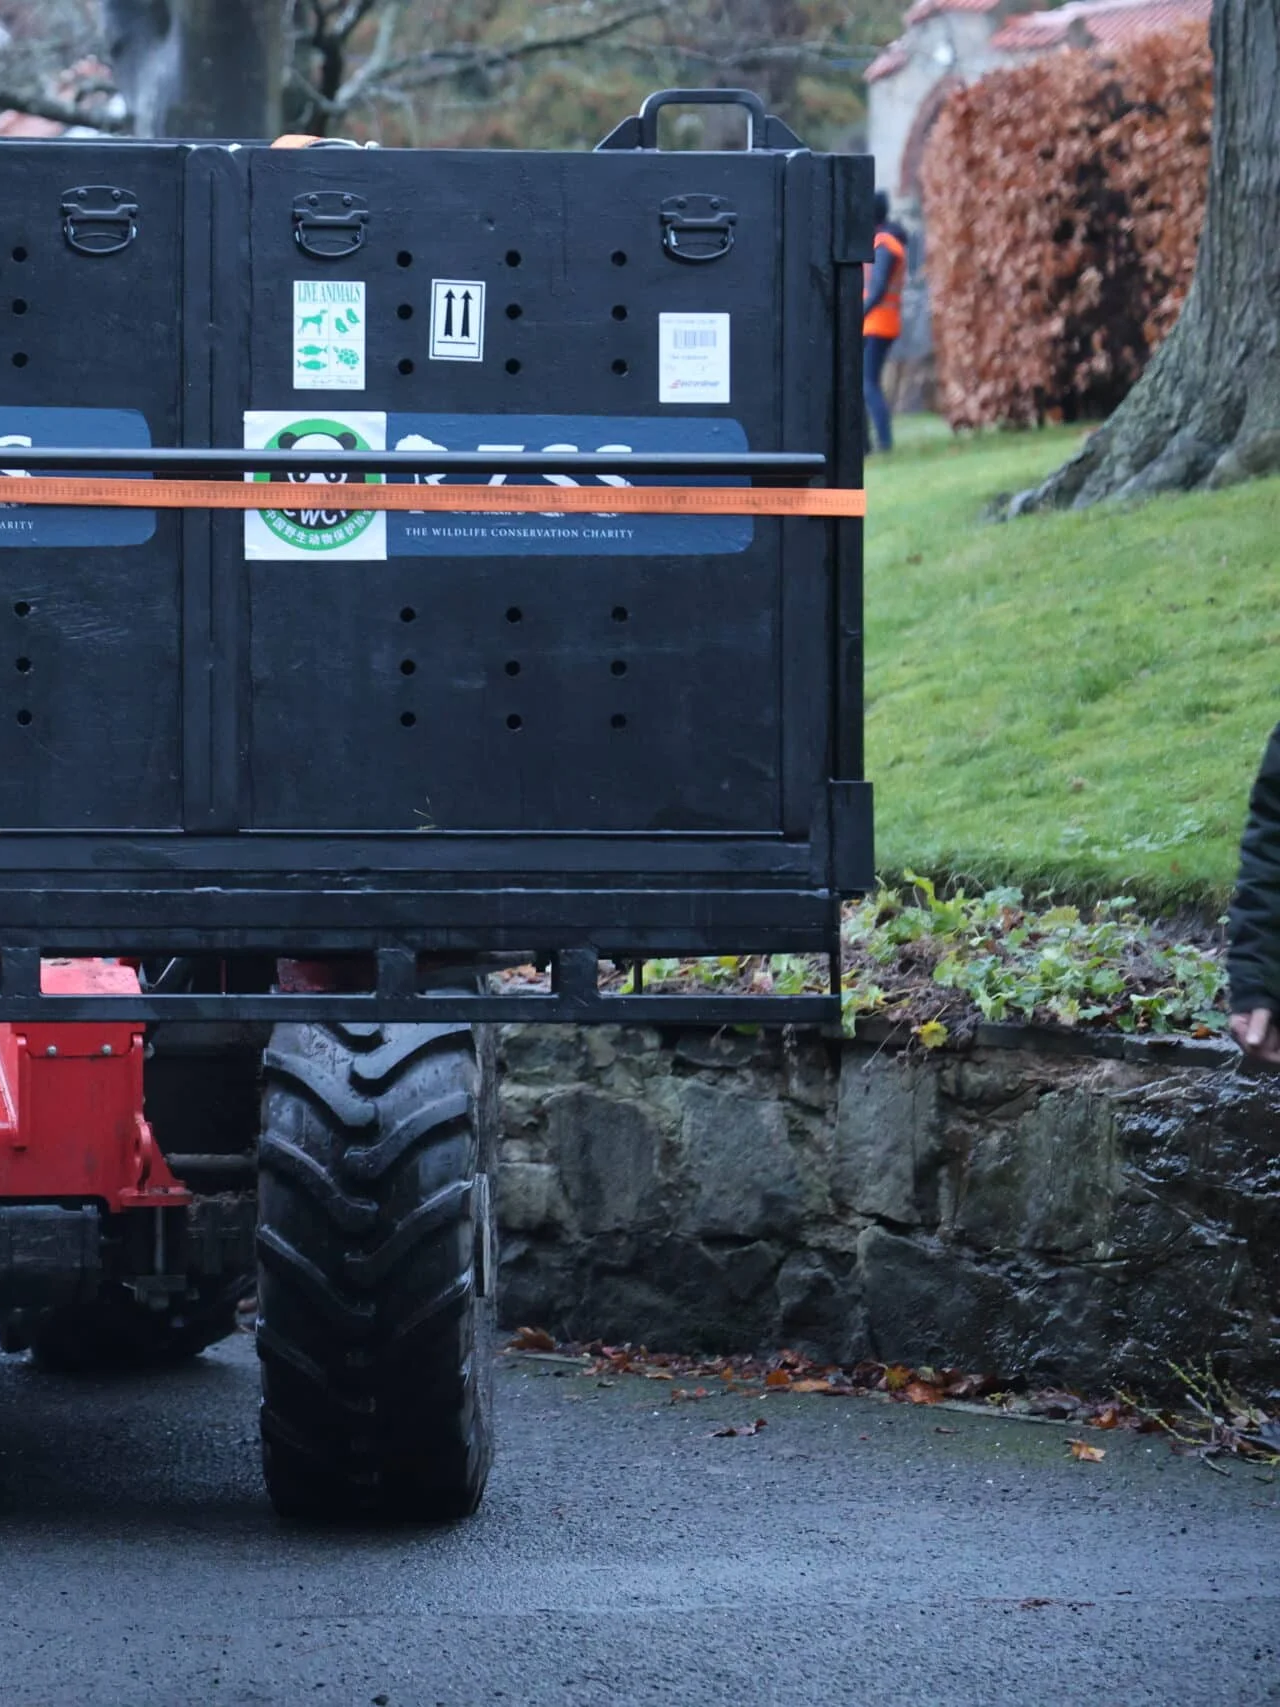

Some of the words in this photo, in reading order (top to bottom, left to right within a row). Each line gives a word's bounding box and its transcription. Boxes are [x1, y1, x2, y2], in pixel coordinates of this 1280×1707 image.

[298, 283, 319, 302] LIVE
[320, 283, 361, 303] ANIMALS
[405, 527, 428, 537] THE
[431, 527, 487, 537] WILDLIFE
[491, 527, 579, 538] CONSERVATION
[582, 528, 635, 539] CHARITY
